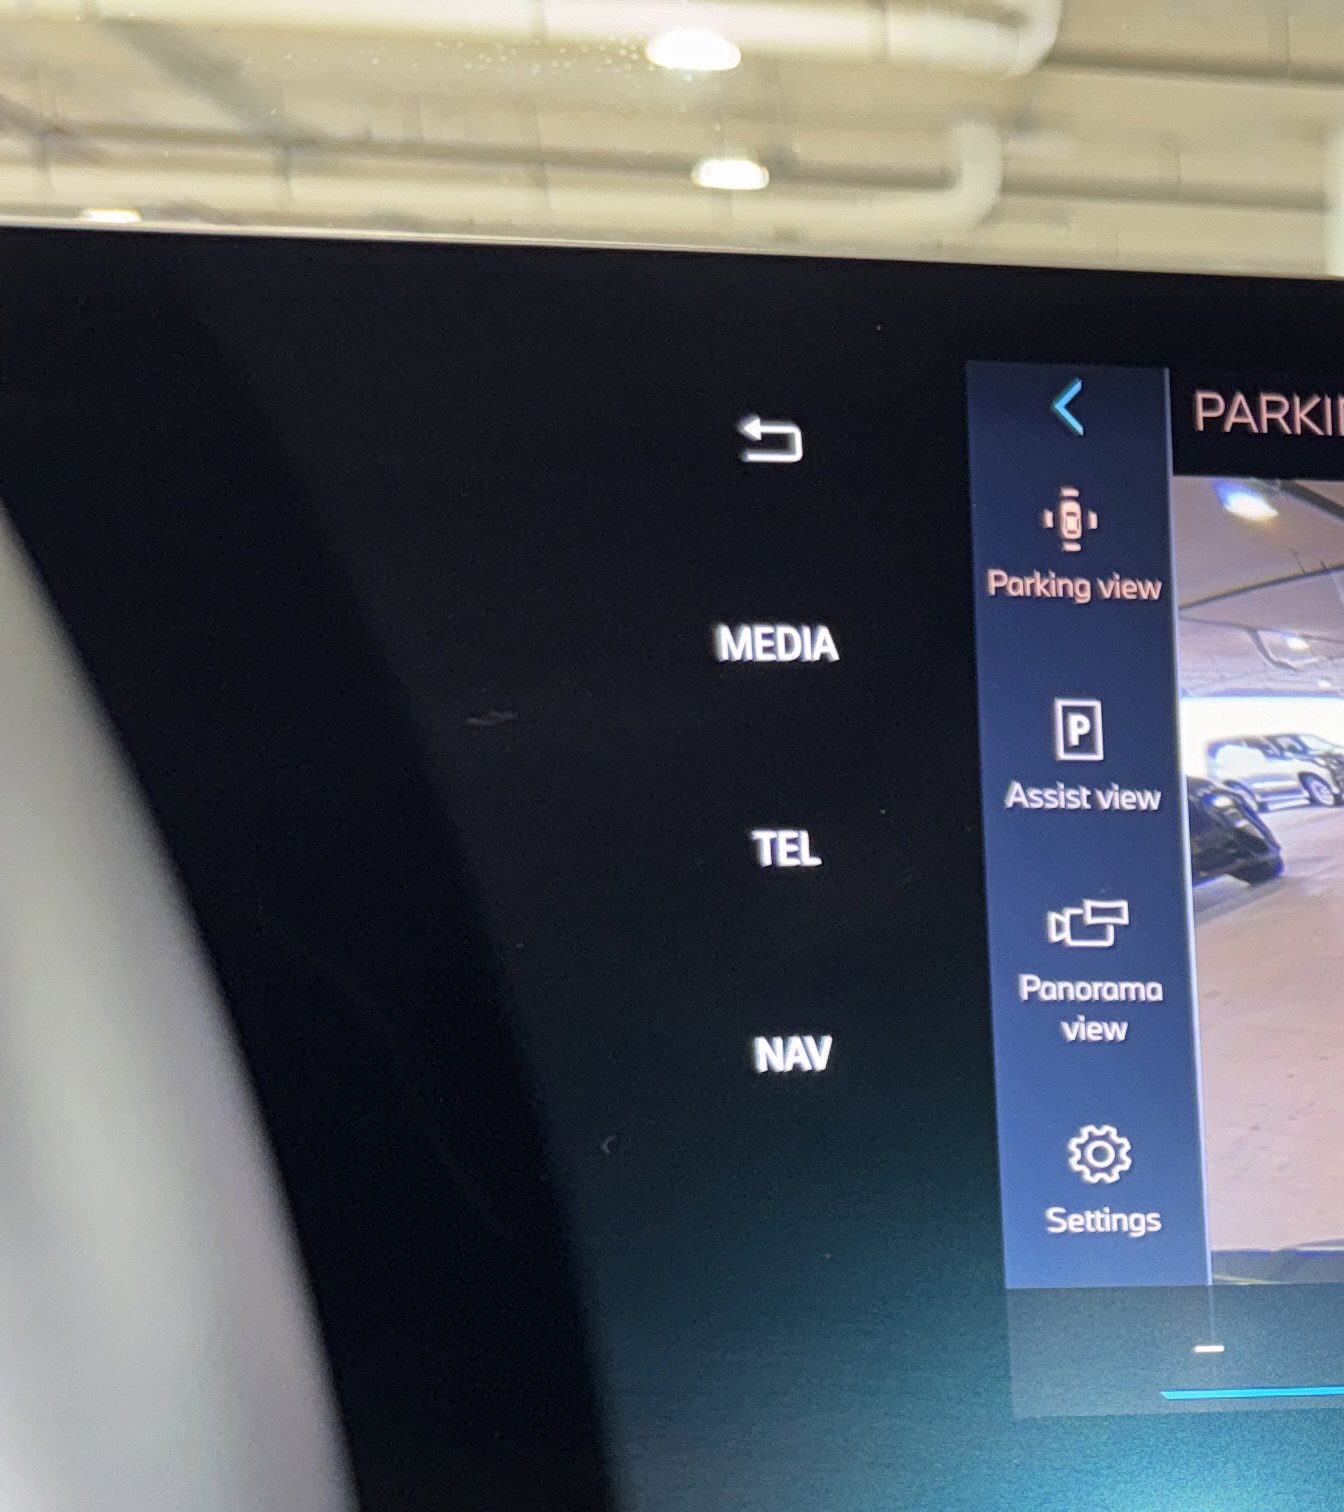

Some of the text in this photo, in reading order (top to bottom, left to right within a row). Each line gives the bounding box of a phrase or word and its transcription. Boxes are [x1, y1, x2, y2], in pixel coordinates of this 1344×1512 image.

[986, 568, 1163, 604] Parking view
[715, 624, 840, 664] MEDIA
[1067, 715, 1091, 747] P
[1005, 780, 1162, 812] Assist view
[752, 829, 822, 868] TEL
[1018, 973, 1164, 1004] Panorama
[1060, 1015, 1129, 1043] view
[753, 1035, 833, 1073] NAV
[1045, 1206, 1163, 1238] Settings
